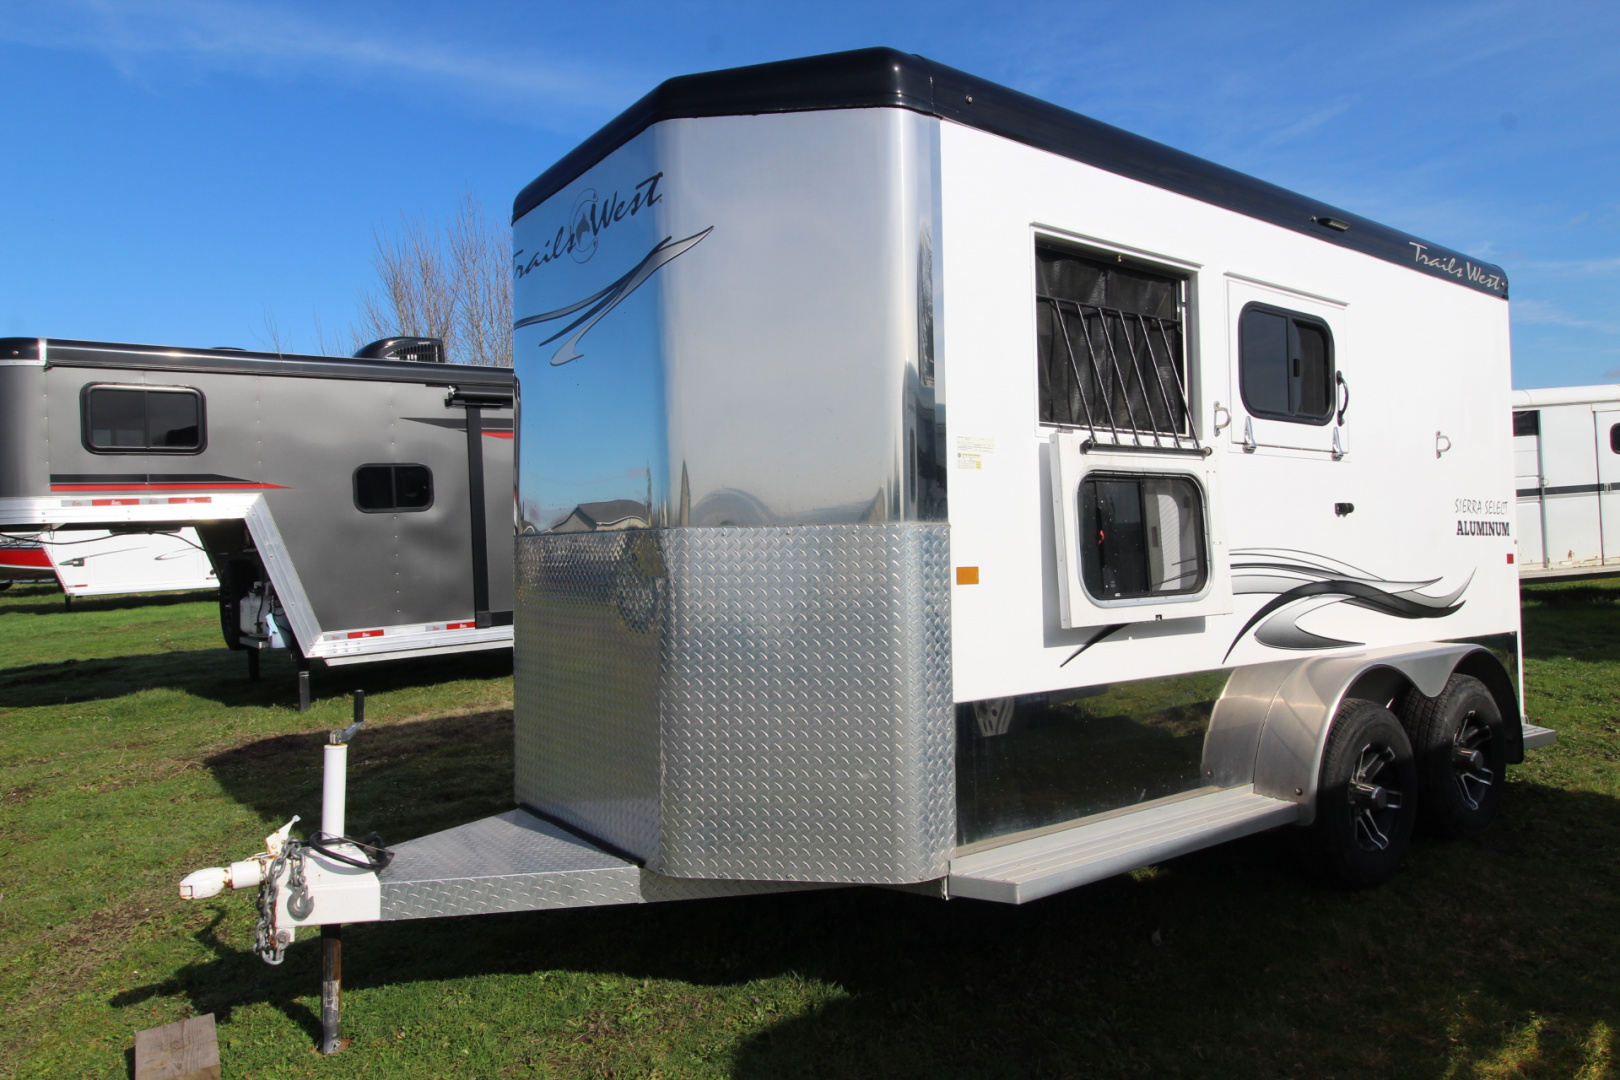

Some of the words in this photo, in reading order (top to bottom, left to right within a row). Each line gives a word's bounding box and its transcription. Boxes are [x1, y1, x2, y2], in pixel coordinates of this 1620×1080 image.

[590, 171, 663, 236] West
[1409, 241, 1463, 277] Trails
[1466, 261, 1500, 290] West
[1454, 498, 1482, 514] SIERRA
[1484, 500, 1508, 515] SELECT
[1456, 520, 1510, 536] ALUMINUM
